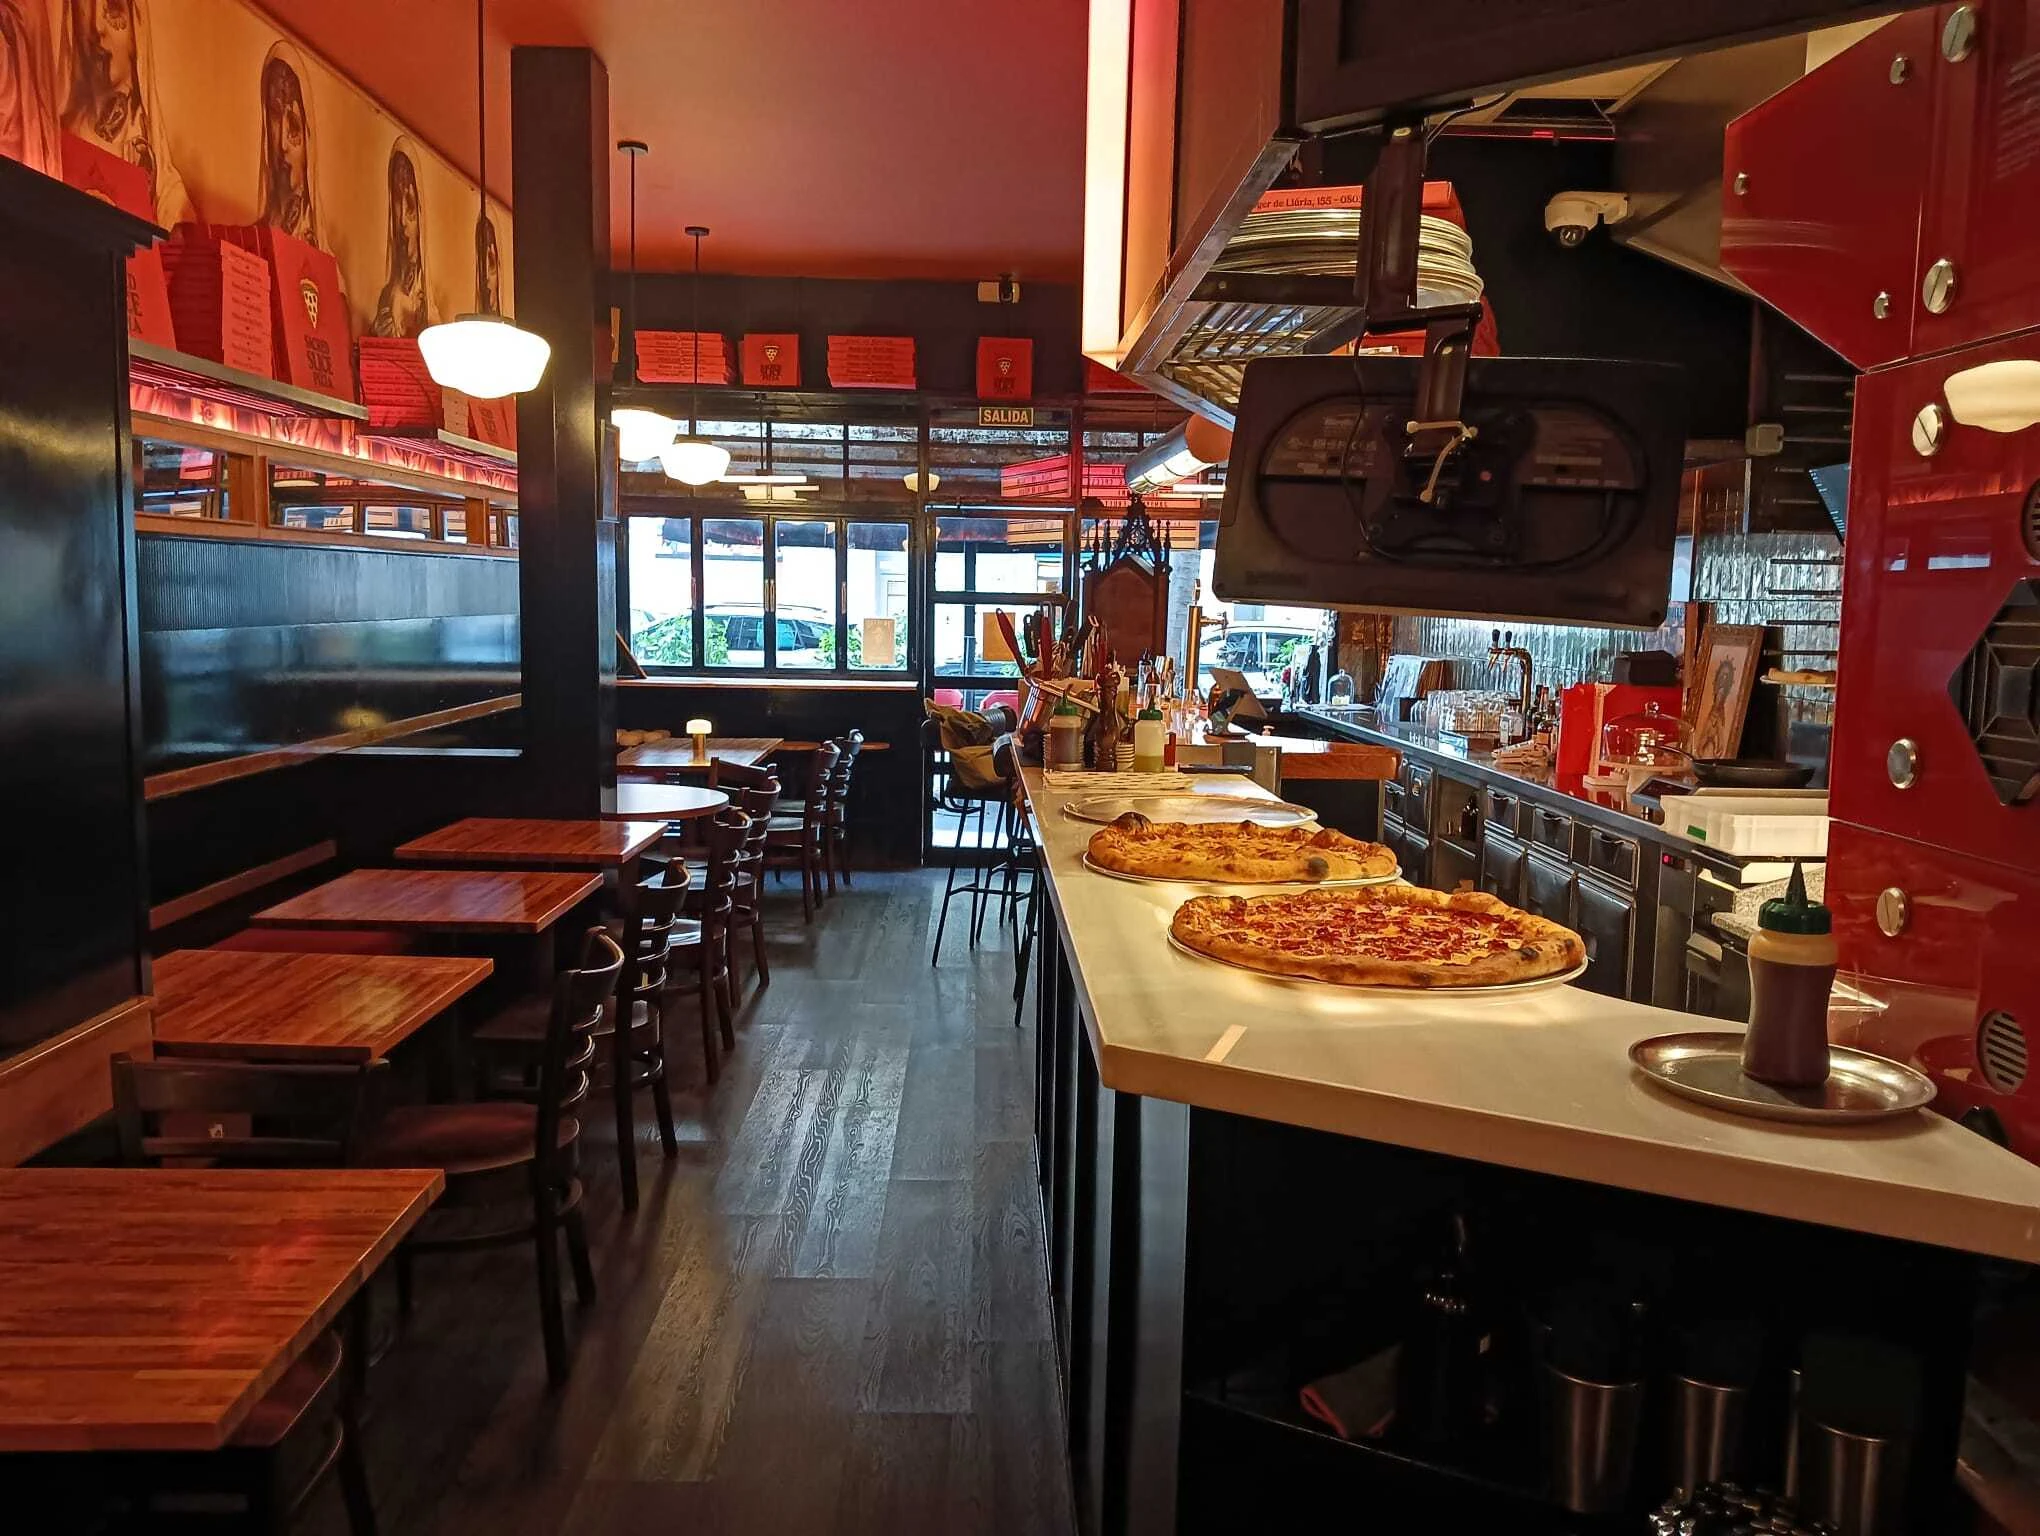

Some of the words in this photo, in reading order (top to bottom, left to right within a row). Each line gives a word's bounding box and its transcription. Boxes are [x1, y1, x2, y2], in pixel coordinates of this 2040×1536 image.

[1257, 200, 1272, 210] ger
[1273, 200, 1285, 209] de
[1316, 196, 1332, 206] 155
[1340, 194, 1362, 204] 080
[983, 409, 1029, 424] SALIDA
